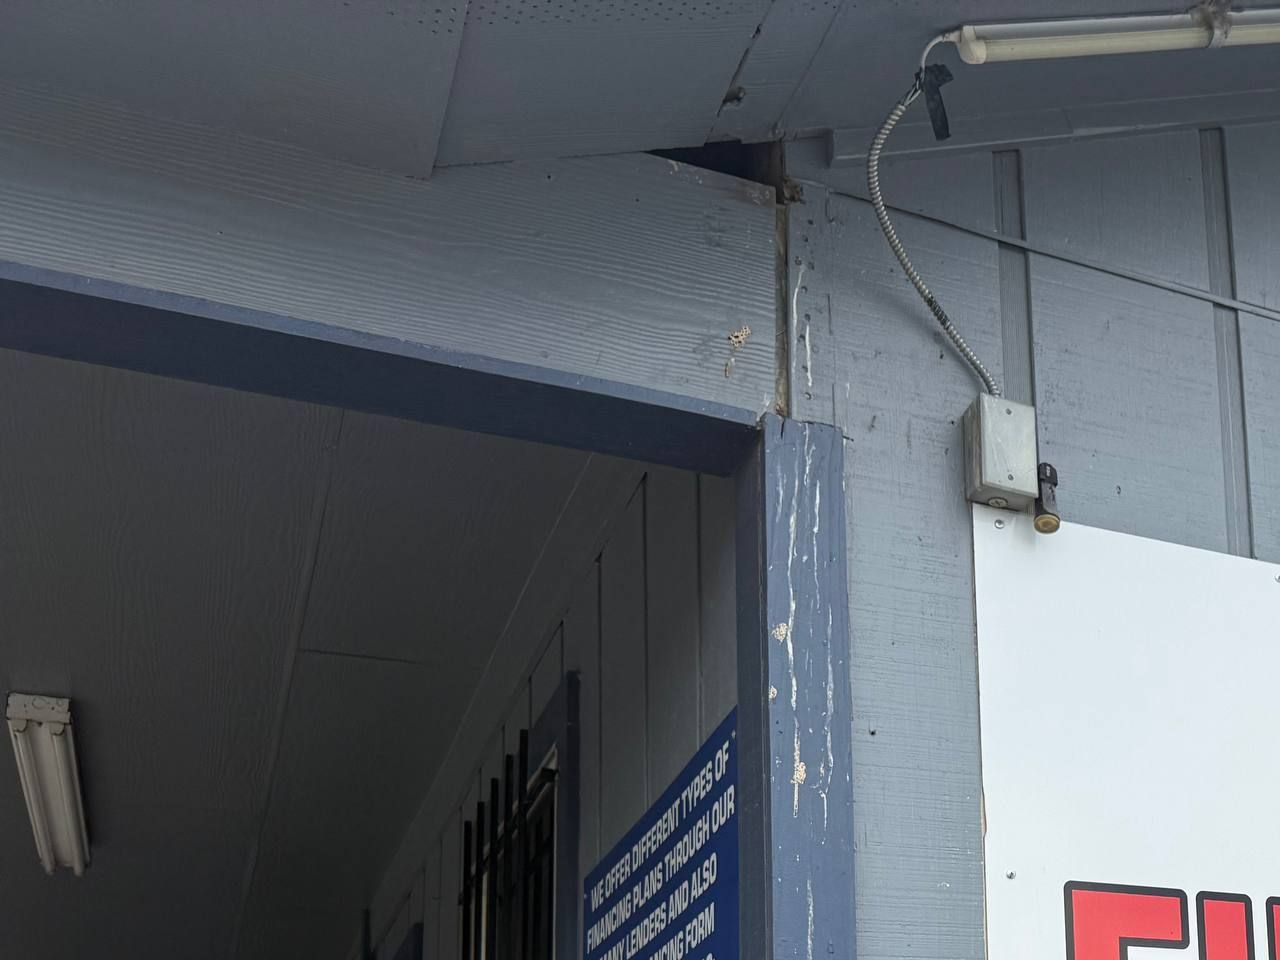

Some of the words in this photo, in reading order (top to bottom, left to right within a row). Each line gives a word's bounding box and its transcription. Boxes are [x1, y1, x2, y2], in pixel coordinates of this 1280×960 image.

[586, 890, 632, 955] FINANCING
[632, 866, 663, 913] PLANS
[664, 809, 710, 882] THROUGH
[711, 783, 735, 834] OUR
[590, 878, 605, 913] WE
[604, 851, 631, 899] OFFER
[632, 797, 680, 873] DIFFERENT
[681, 759, 713, 819] TYPES
[714, 740, 730, 782] OF
[625, 901, 667, 960] LENDERS
[667, 879, 689, 925] AND
[690, 852, 718, 904] ALSO
[685, 901, 715, 955] FORM
